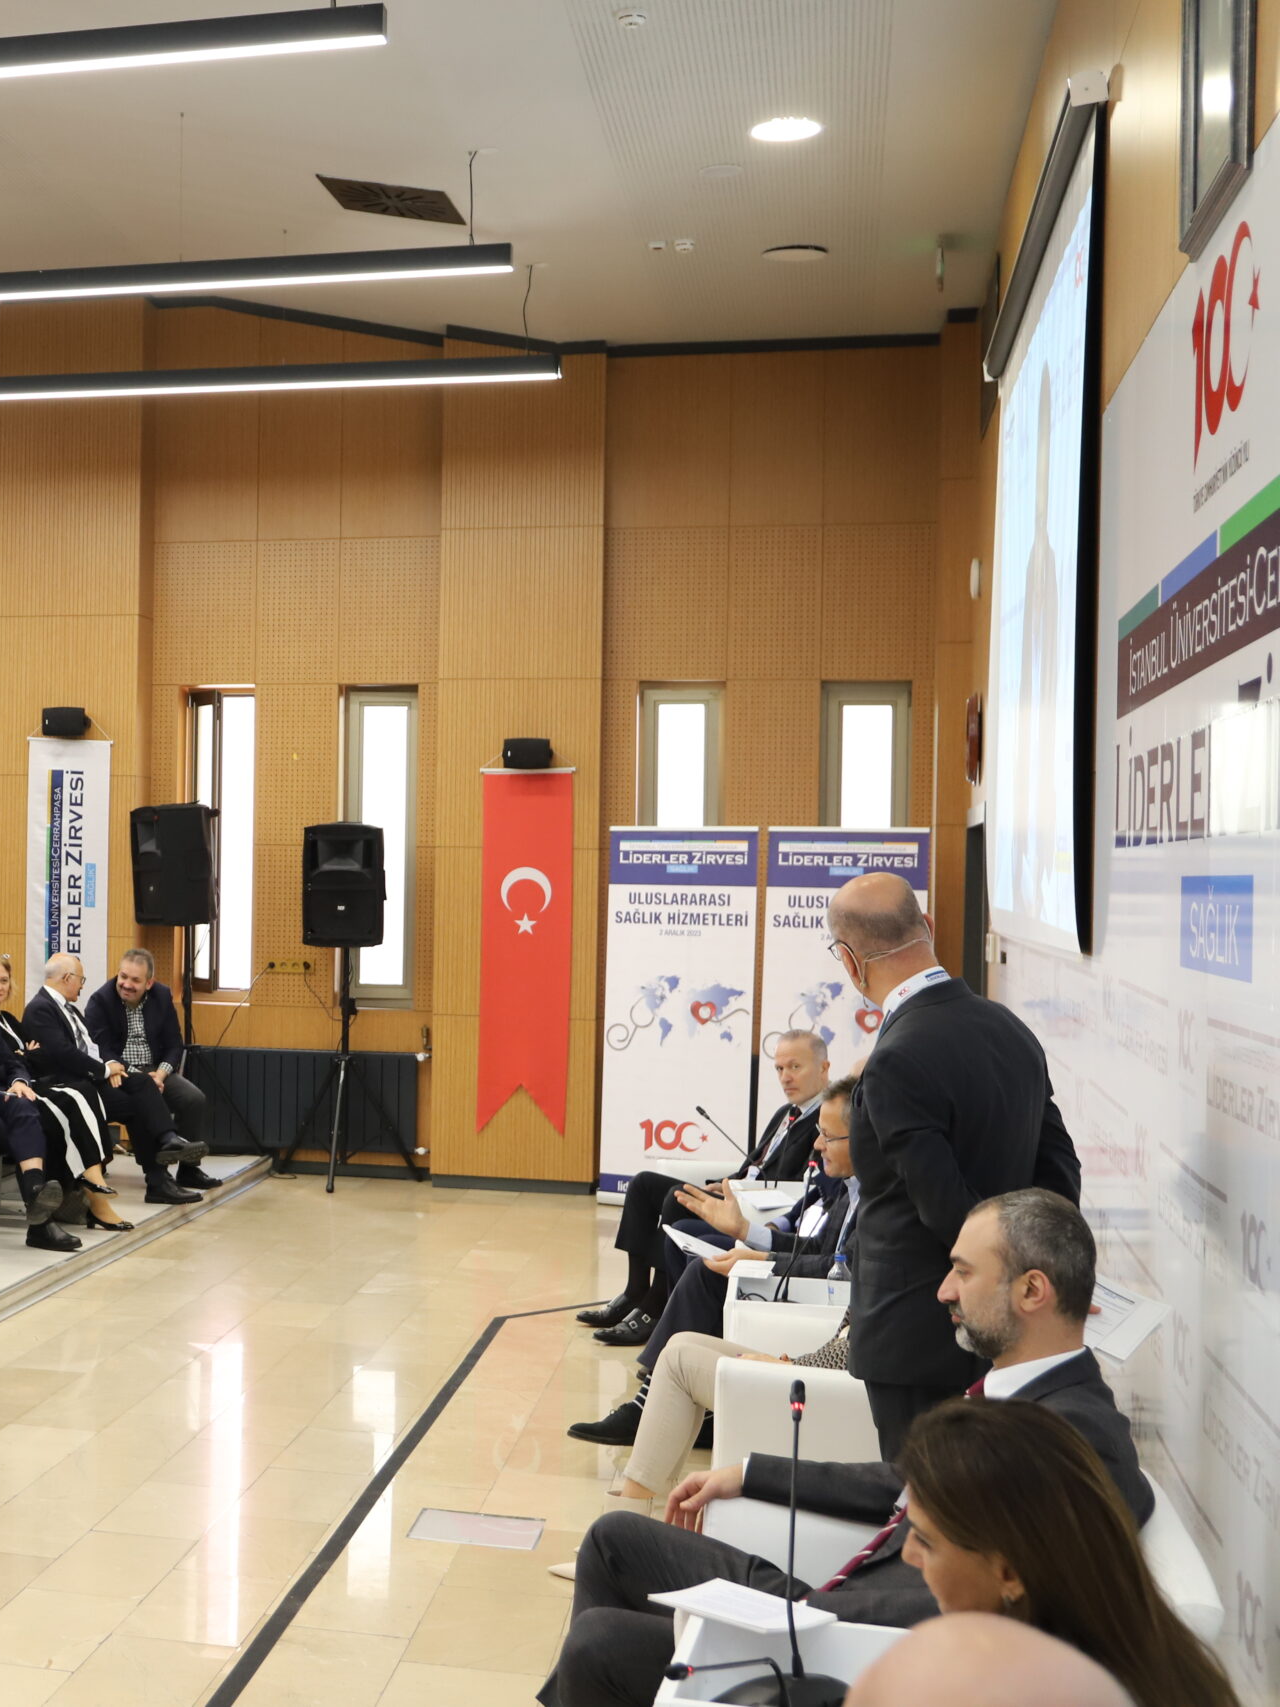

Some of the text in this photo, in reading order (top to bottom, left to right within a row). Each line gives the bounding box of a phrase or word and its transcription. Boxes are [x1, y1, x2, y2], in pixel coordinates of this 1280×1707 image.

[1129, 546, 1280, 697] İSTANBUL ÜNİVERSİTESİ-CE
[63, 770, 84, 954] ERLER ZİRVESİ
[619, 850, 748, 865] LİDERLER ZİRVESİ
[778, 851, 918, 868] LİDERLER ZİRVESİ
[628, 891, 731, 907] ULUSLARARASI
[615, 908, 749, 927] SAĞLIK HİZMETLERİ
[772, 911, 824, 929] SAĞLIK
[1189, 885, 1240, 967] SAĞLIK
